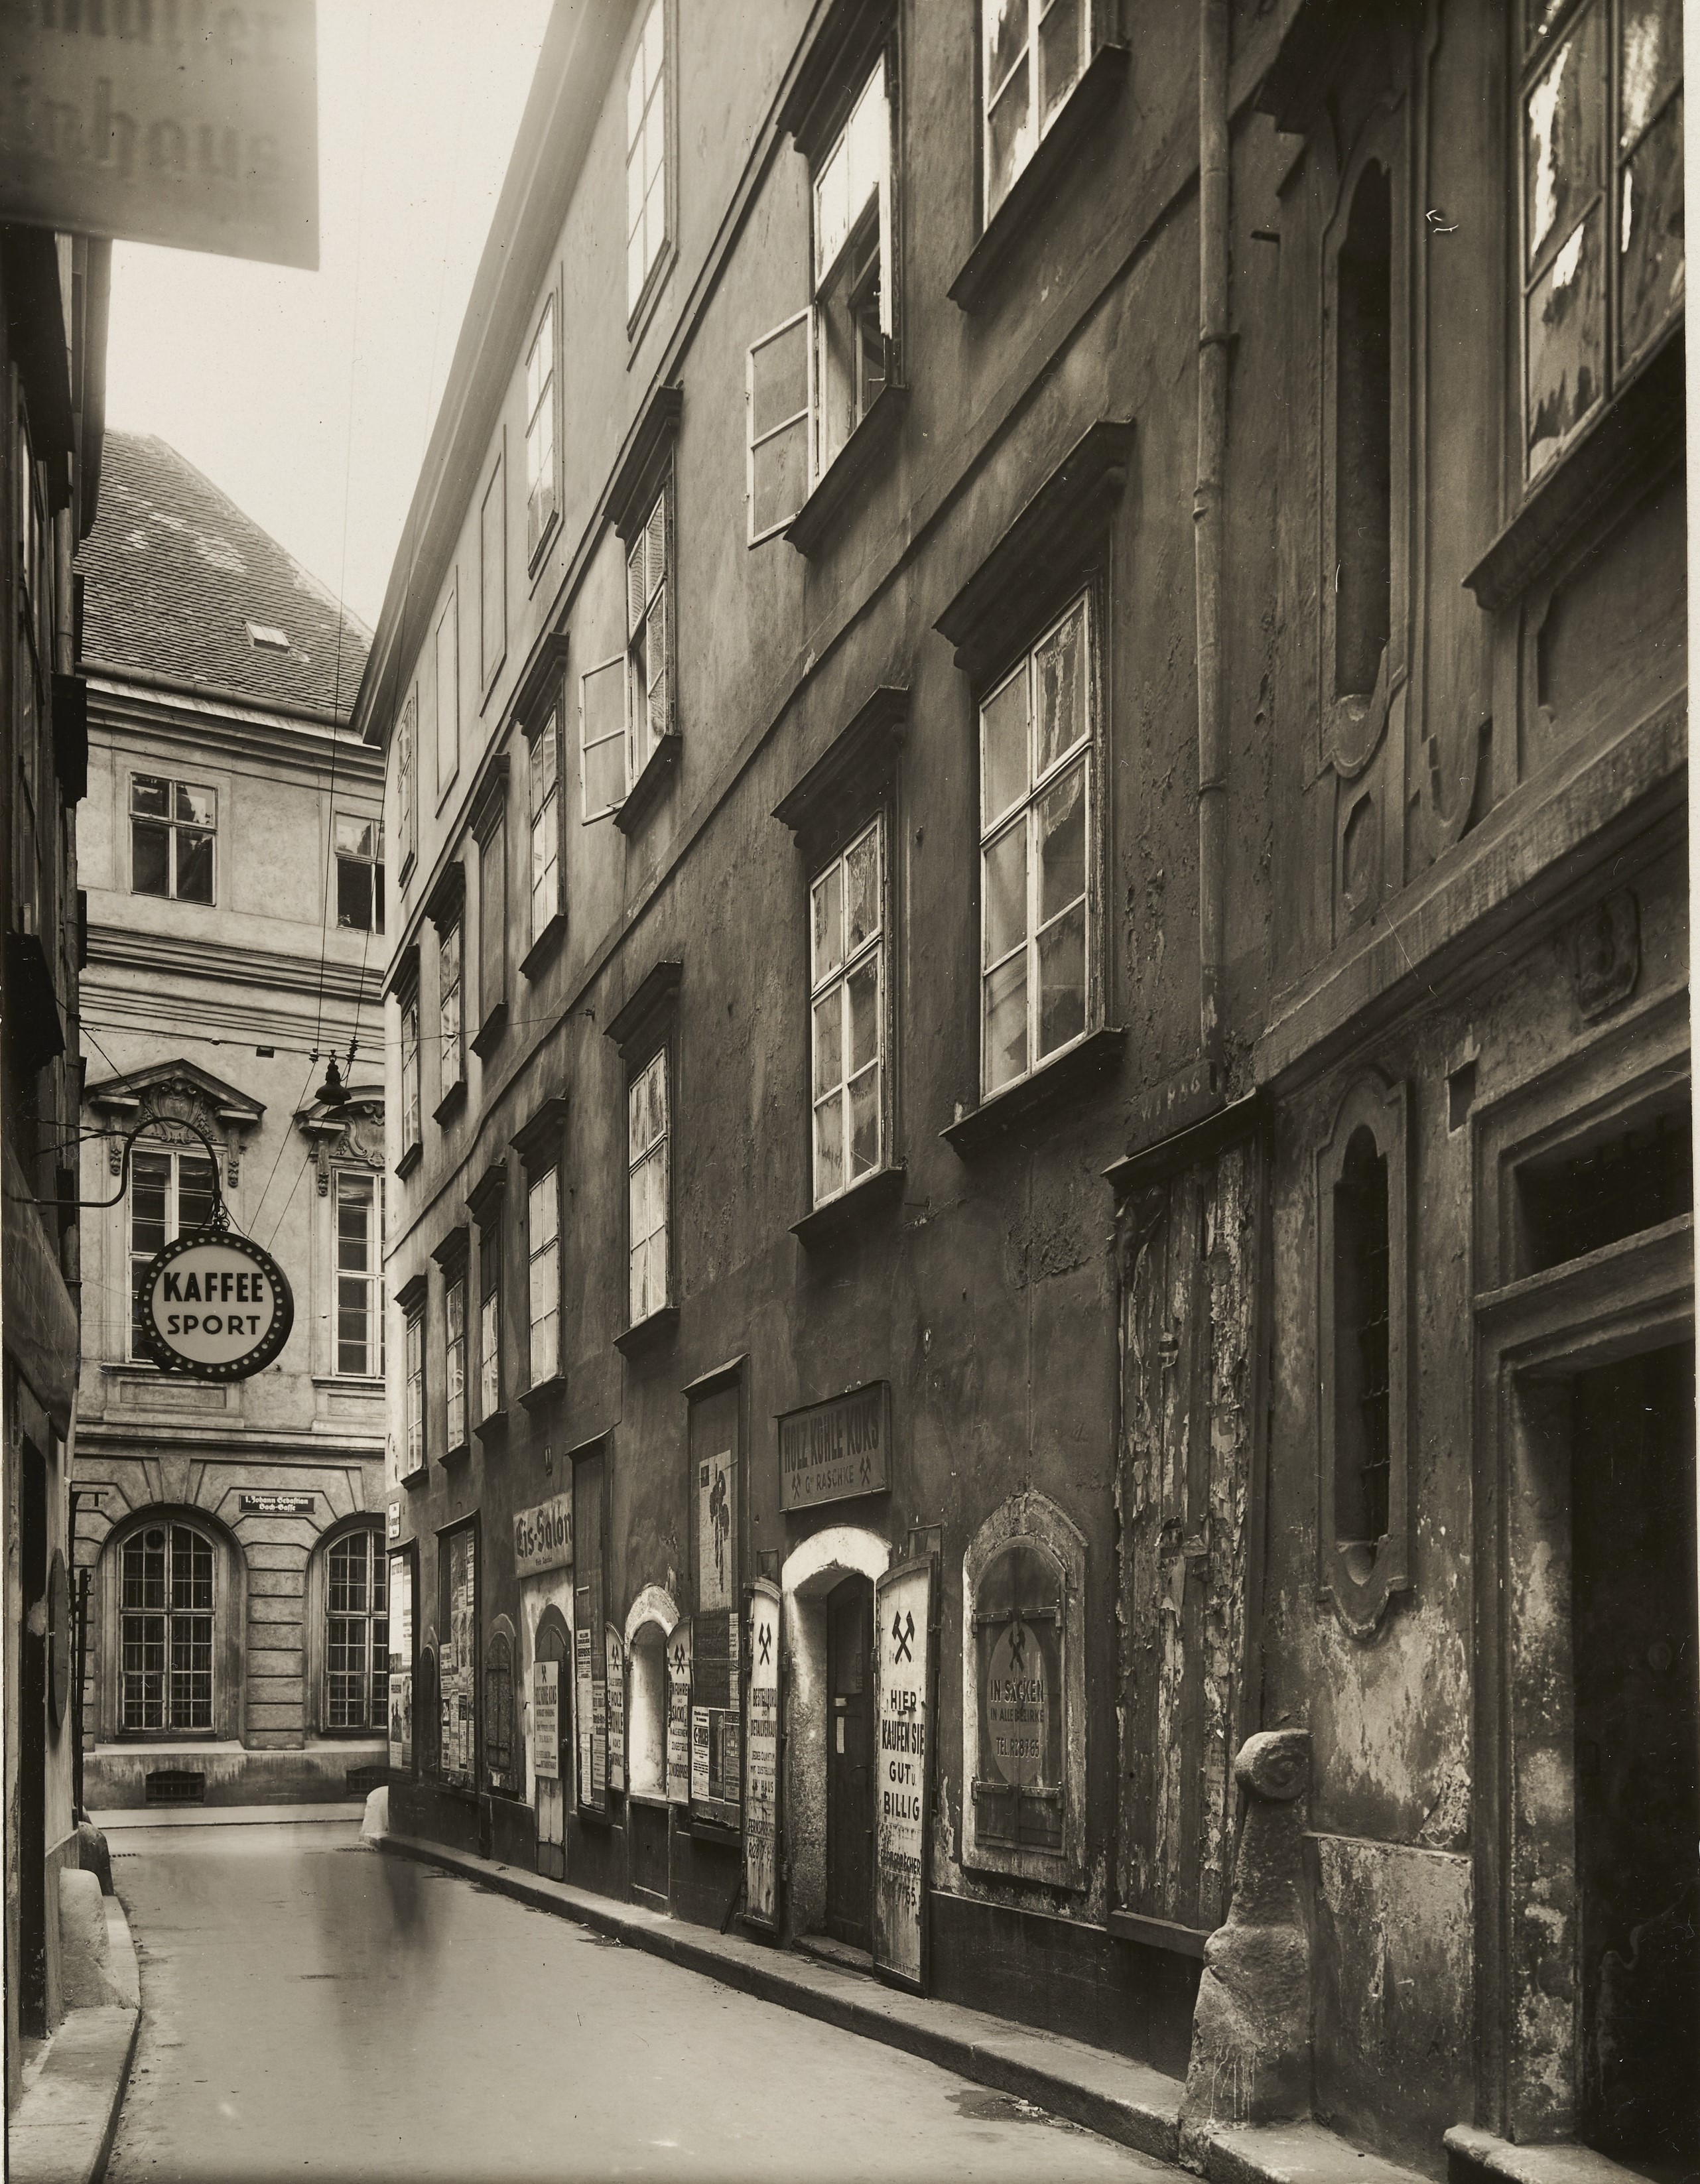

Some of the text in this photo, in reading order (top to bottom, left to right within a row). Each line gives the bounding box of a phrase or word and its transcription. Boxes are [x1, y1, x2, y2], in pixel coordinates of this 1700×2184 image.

[164, 1271, 264, 1303] KAFFEE
[167, 1315, 261, 1336] SPORT
[846, 1404, 880, 1456] KOKS
[817, 1464, 854, 1491] RASCHKE
[251, 1496, 276, 1504] Johann
[517, 1510, 572, 1558] Eis-Salon
[611, 1691, 622, 1707] HOLZ
[891, 1689, 917, 1711] HIER
[990, 1677, 1045, 1703] IN SÄCKEN
[990, 1708, 1045, 1722] IN ALLE BEZIRKE
[882, 1719, 925, 1755] KAUFEN SIE
[996, 1737, 1010, 1757] TEL.
[752, 1750, 761, 1760] JEDES
[889, 1761, 911, 1784] GUT
[761, 1780, 774, 1793] HAUS
[883, 1791, 919, 1821] BILLIG
